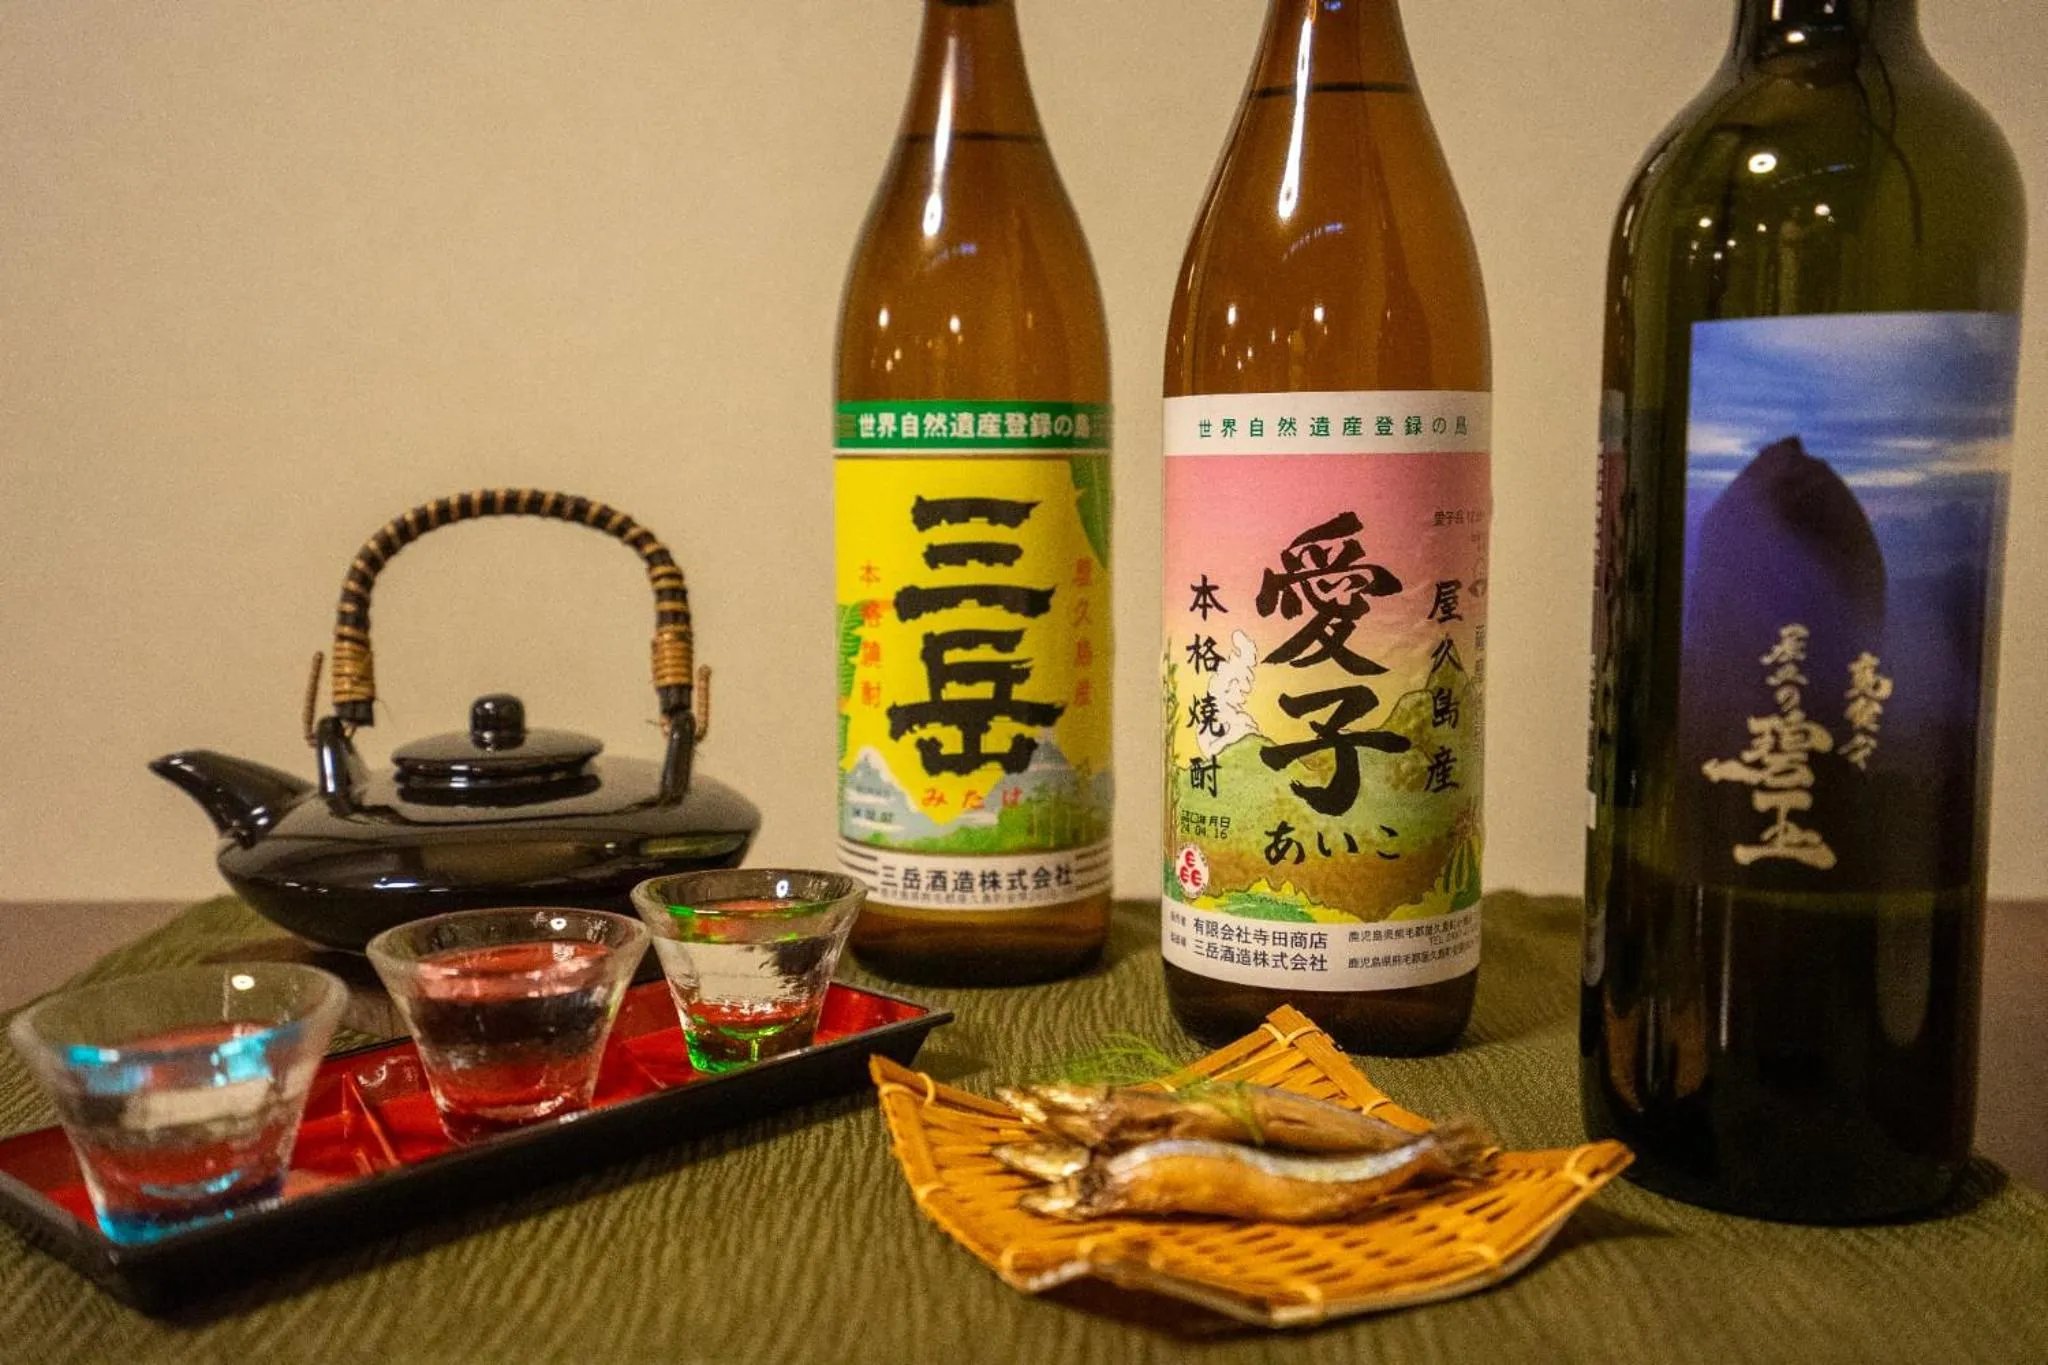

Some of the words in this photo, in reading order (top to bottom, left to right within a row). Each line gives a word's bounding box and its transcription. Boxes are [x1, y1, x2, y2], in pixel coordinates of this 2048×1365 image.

[858, 411, 1091, 440] 世界自然遺産登録の島
[1198, 415, 1468, 438] 世界自然遺産登録の島
[886, 494, 1066, 777] 三岳
[1255, 510, 1412, 817] 愛子
[1424, 580, 1465, 795] 屋久島産
[921, 786, 1023, 809] みたけ
[1264, 819, 1401, 866] あいこ
[881, 862, 1074, 893] 三岳酒造株式会社
[1194, 917, 1329, 950] 有限会社寺田商店
[1194, 939, 1329, 972] 三岳酒造株式会社
